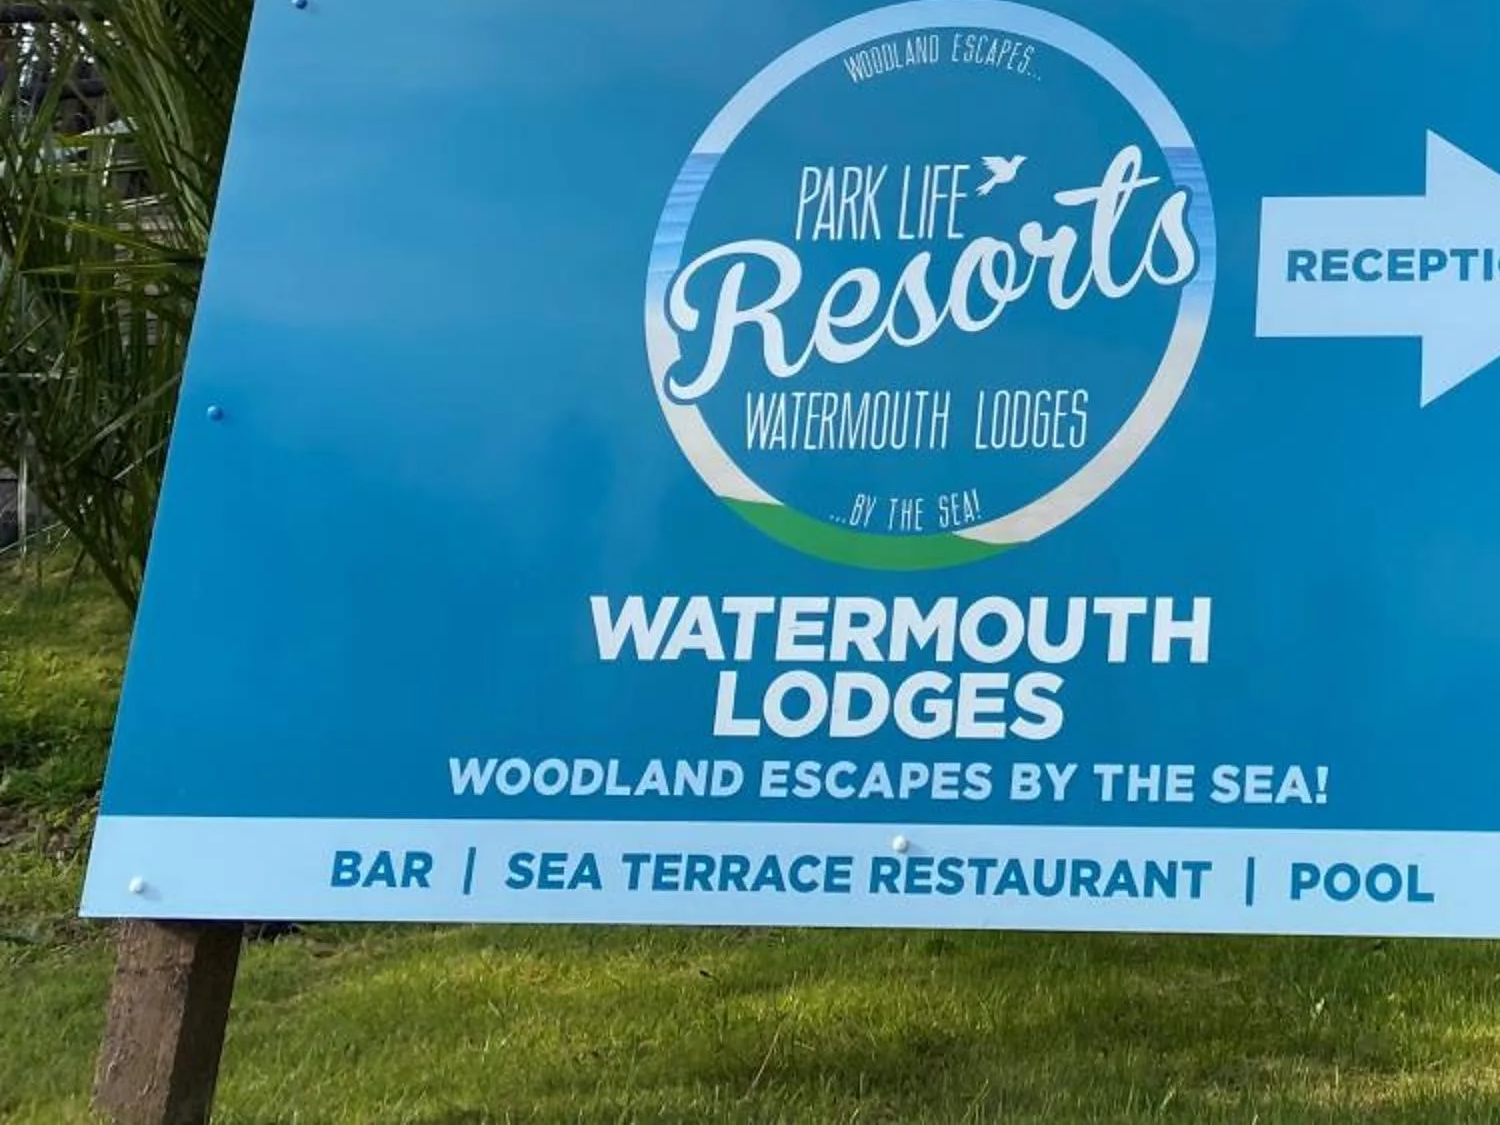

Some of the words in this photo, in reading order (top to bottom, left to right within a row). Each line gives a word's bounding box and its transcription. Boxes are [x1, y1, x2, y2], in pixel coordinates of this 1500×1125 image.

[843, 33, 940, 83] WOODLAND
[795, 165, 888, 241] PARK
[899, 163, 971, 241] LIFE
[669, 144, 1196, 400] Resorts
[745, 390, 951, 451] WATERMOUTH
[974, 389, 1090, 450] LODGES
[888, 497, 924, 531] THE
[938, 488, 983, 530] SEA!
[589, 595, 1212, 665] WATERMOUTH
[712, 669, 1065, 741] LODGES
[448, 757, 745, 797] WOODLAND
[759, 760, 993, 801] ESCAPES
[1008, 761, 1079, 801] BY
[1092, 763, 1196, 803] THE
[1208, 764, 1331, 805] SEA!
[331, 849, 434, 889] BAR
[504, 851, 603, 891] SEA
[621, 852, 854, 894] TERRACE
[868, 855, 1214, 900] RESTAURANT
[1290, 861, 1436, 904] POOL
